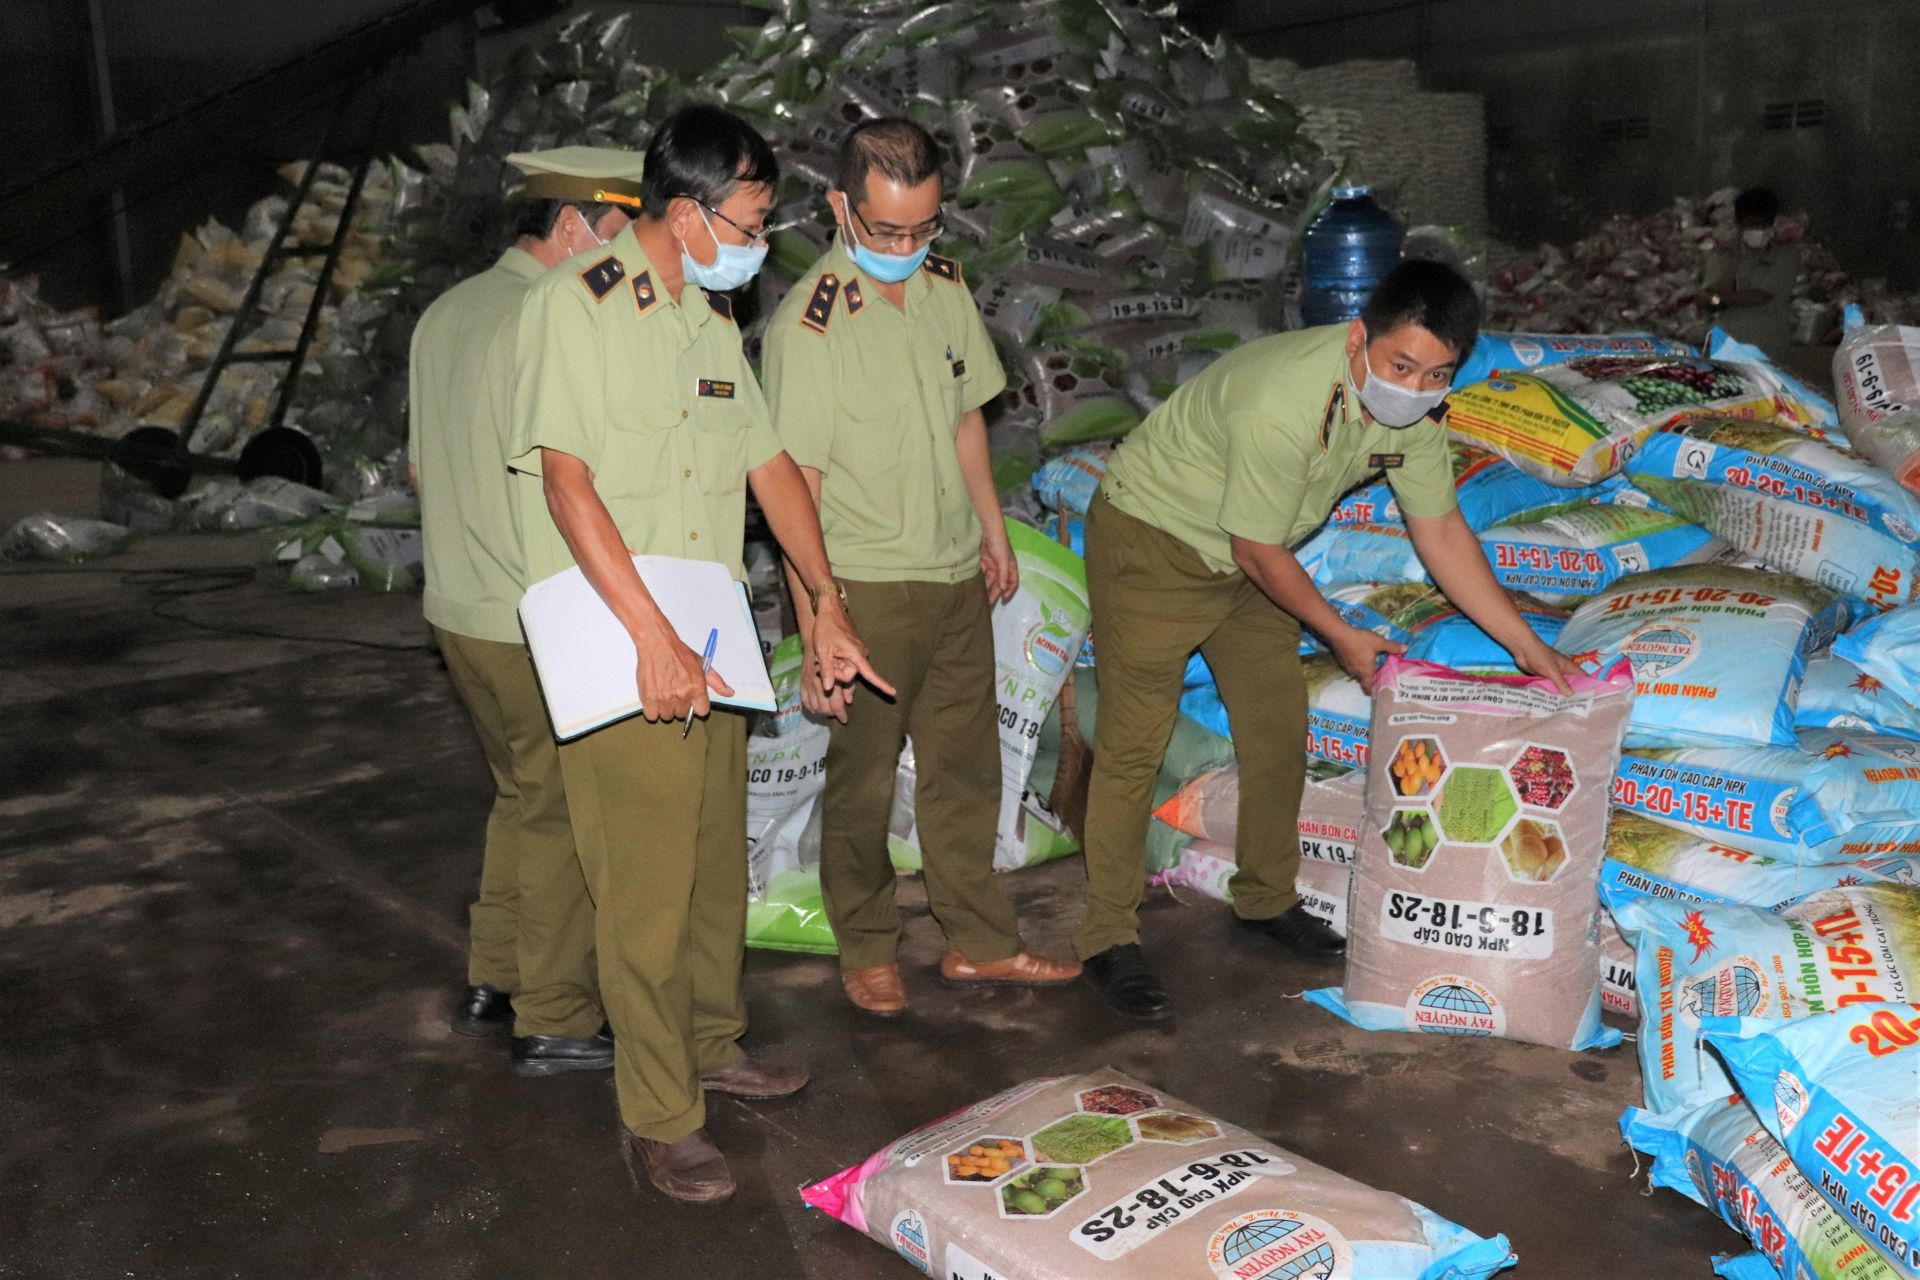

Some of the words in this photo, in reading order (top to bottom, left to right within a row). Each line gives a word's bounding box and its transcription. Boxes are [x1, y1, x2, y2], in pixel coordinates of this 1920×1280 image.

[1636, 682, 1650, 698] TÂ
[1724, 779, 1748, 794] NPK
[1614, 778, 1753, 831] 20-20-15+TE
[1444, 931, 1473, 949] CAO
[1478, 936, 1510, 952] NPK
[1212, 1168, 1252, 1195] NPK
[1821, 1169, 1848, 1207] NPK
[1081, 1150, 1270, 1243] 18-6-18-2S
[1179, 1188, 1216, 1210] CAO
[1879, 1224, 1908, 1261] CAO
